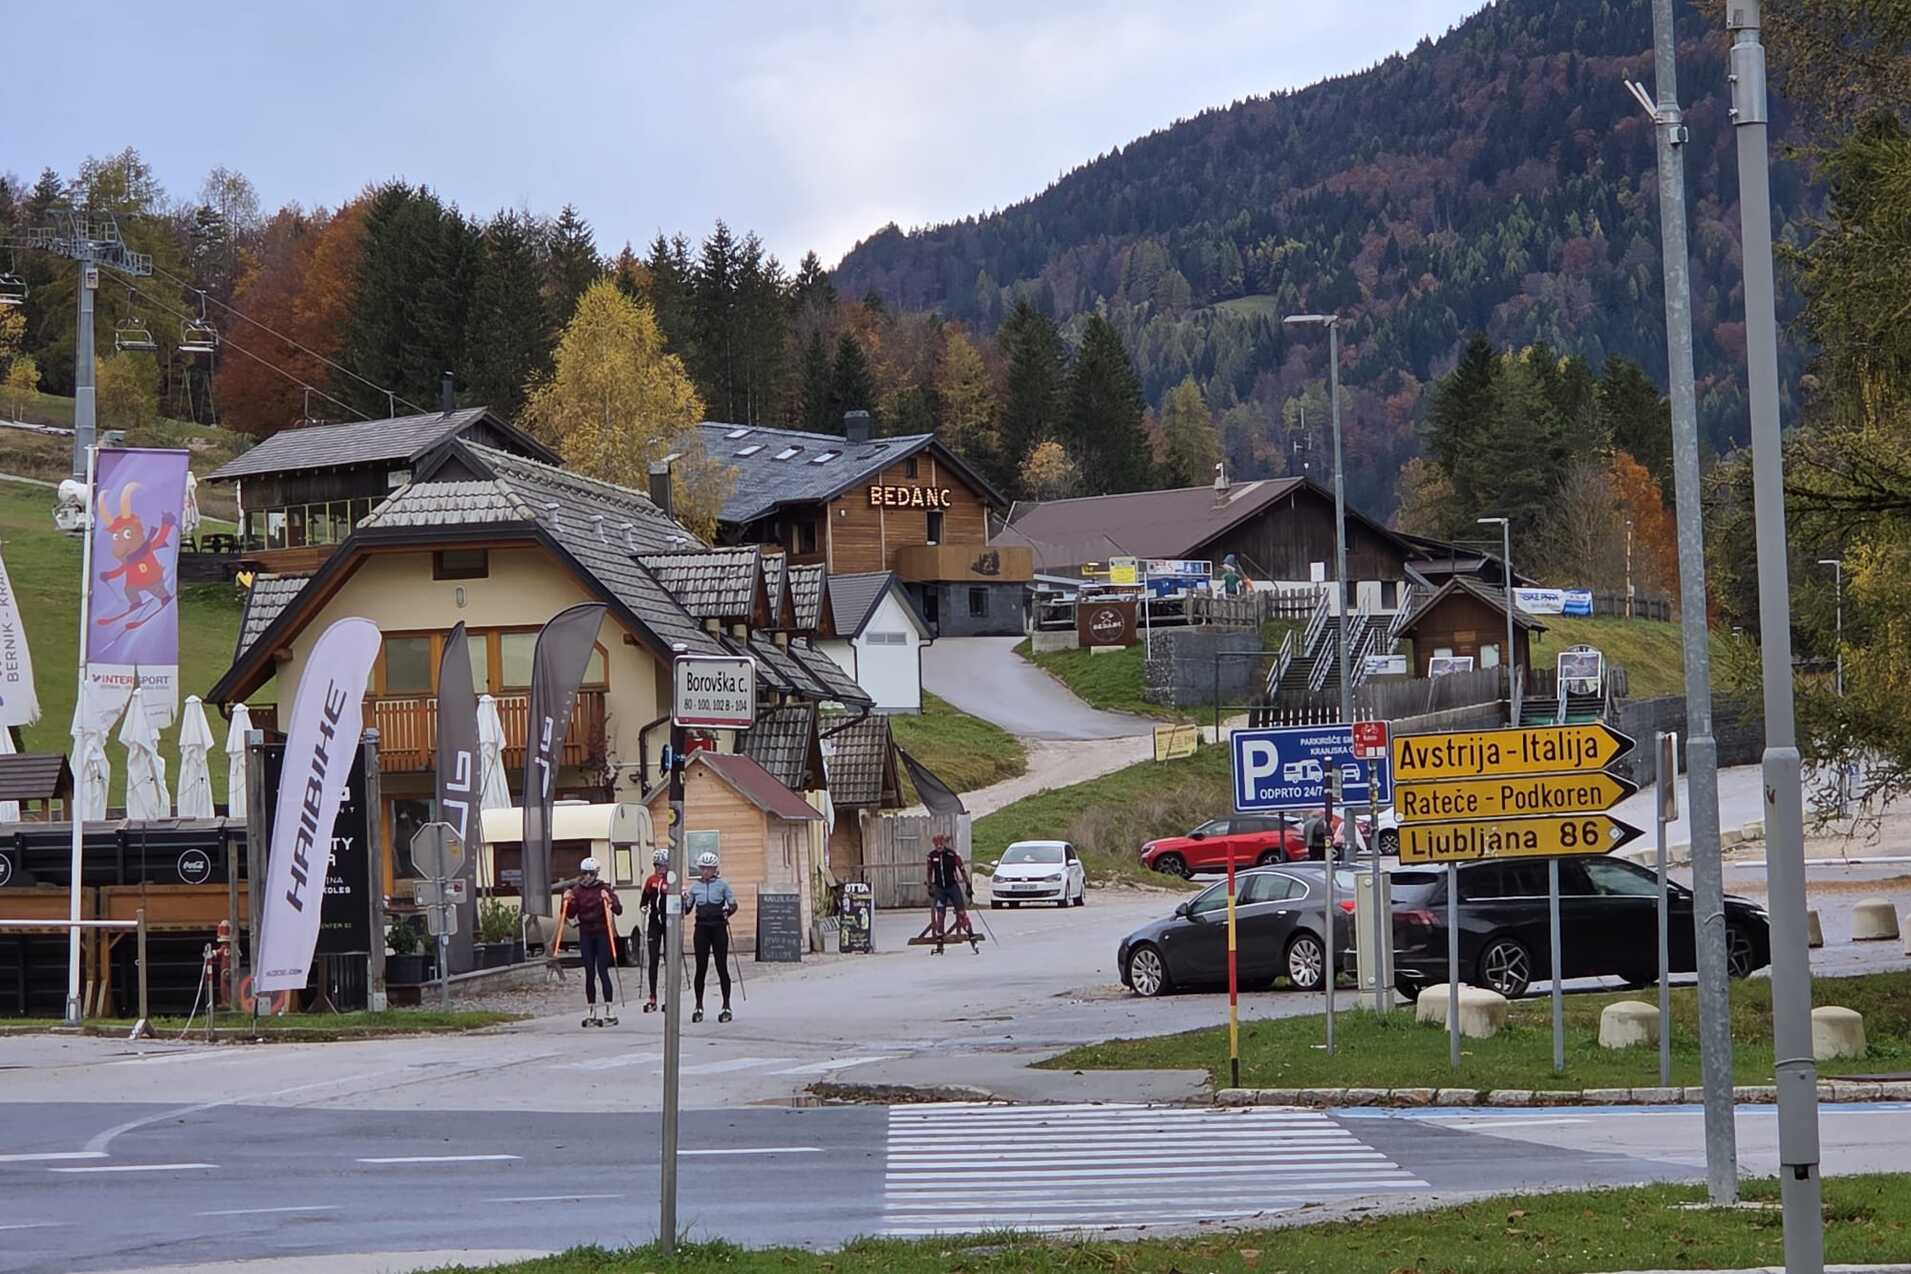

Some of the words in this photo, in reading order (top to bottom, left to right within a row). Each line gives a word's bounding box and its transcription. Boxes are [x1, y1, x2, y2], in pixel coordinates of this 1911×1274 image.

[870, 486, 951, 507] BEDANC
[2, 621, 19, 682] BERNIK
[102, 675, 169, 685] INTERPORT
[687, 671, 735, 692] Borovška
[738, 677, 747, 692] c.
[1400, 737, 1500, 773] Avstrija
[1522, 731, 1598, 767] Italija
[1242, 739, 1279, 801] P
[286, 678, 347, 912] HAIBIKE
[1260, 786, 1302, 800] ODPRTO
[1304, 785, 1323, 798] 24/7
[1404, 788, 1478, 816] Rateče
[1501, 783, 1602, 810] Podkoren
[1411, 826, 1538, 858] Ljubljana
[1560, 820, 1599, 848] 86
